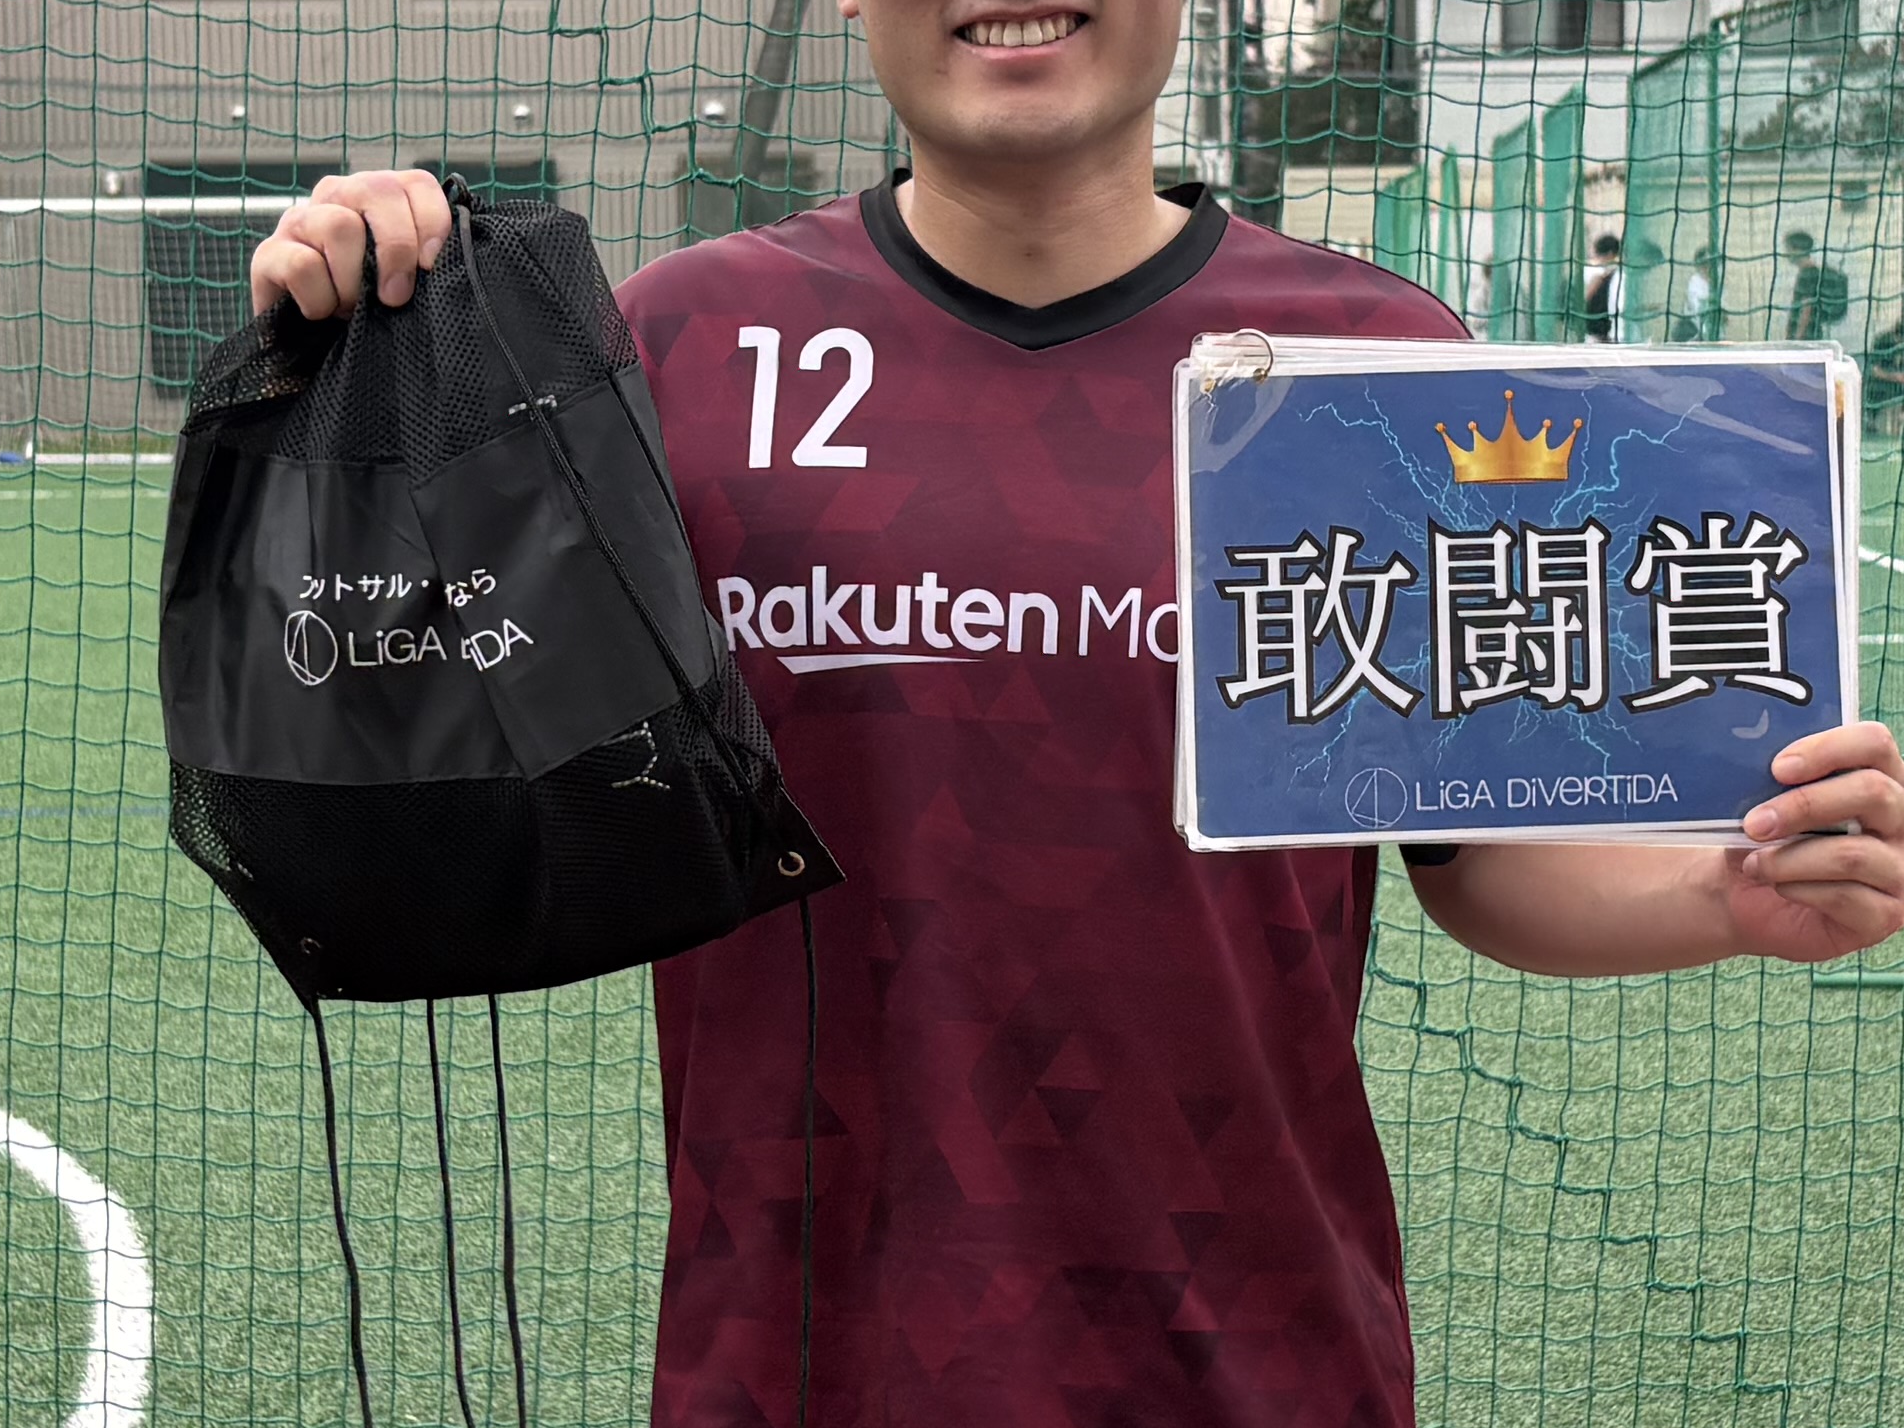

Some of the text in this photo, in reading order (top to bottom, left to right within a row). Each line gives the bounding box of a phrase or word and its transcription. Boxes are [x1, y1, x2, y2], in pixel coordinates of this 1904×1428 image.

[738, 326, 874, 469] 12
[717, 565, 1060, 657] Rakuten
[1218, 514, 1810, 722] 敢闘賞
[1415, 778, 1496, 812] LiGA
